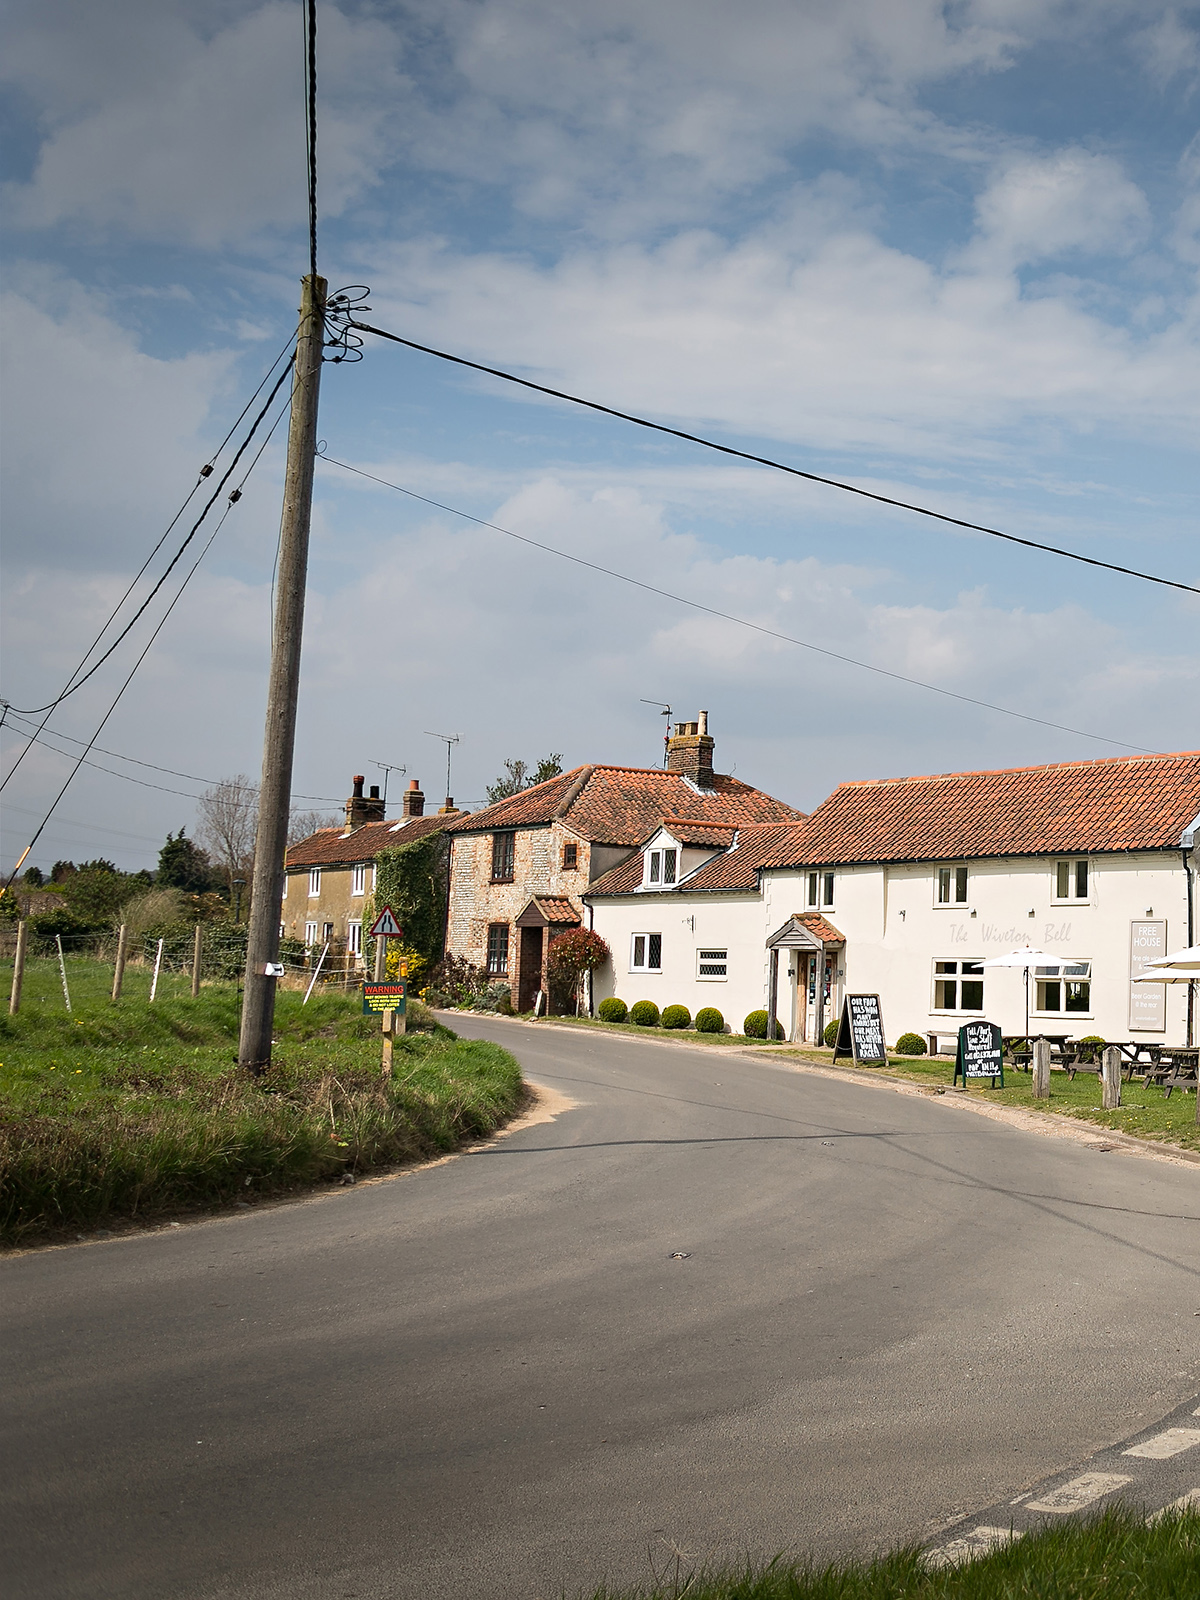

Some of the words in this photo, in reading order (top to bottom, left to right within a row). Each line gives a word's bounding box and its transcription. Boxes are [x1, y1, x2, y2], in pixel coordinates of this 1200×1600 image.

[950, 924, 968, 943] The
[981, 922, 1031, 943] Wiveton
[1044, 922, 1072, 944] Bell
[1138, 926, 1157, 936] FREE
[1133, 937, 1161, 947] HOUSE
[364, 985, 404, 993] WARNING
[1131, 992, 1142, 1000] Beer
[1143, 992, 1162, 1000] Garden
[853, 1006, 865, 1014] HAS
[854, 1026, 865, 1035] OUR
